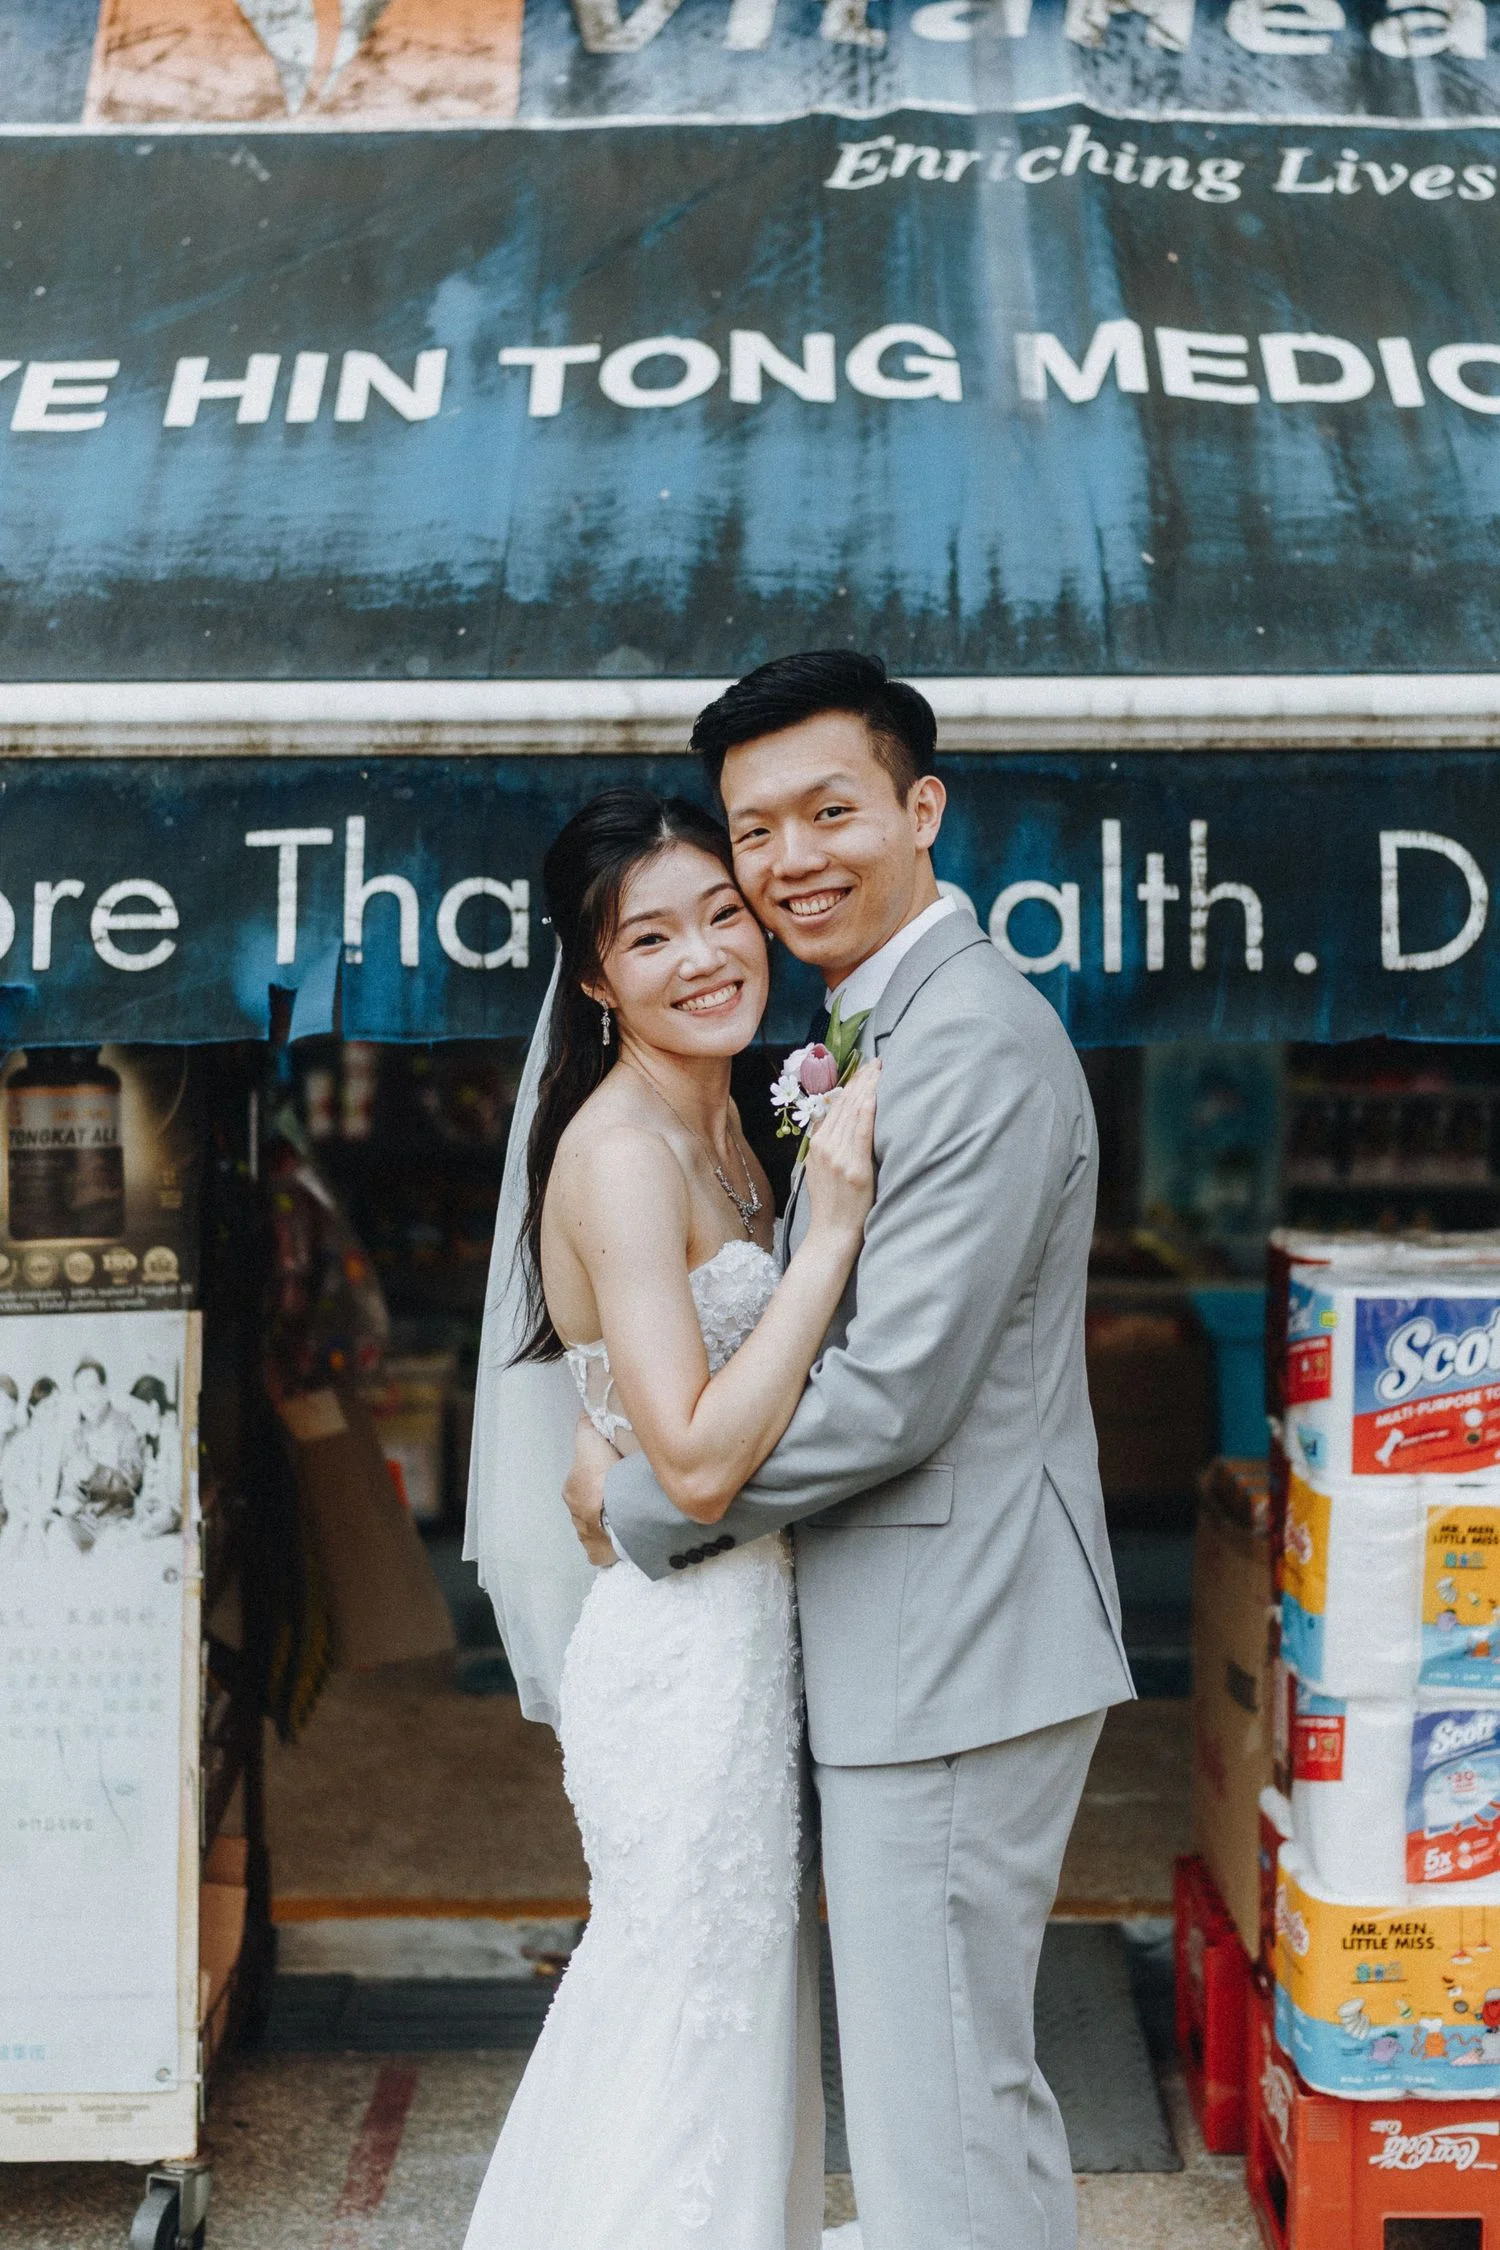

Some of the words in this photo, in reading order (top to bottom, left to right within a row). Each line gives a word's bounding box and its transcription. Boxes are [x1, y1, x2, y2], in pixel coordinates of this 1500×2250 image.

[823, 124, 1245, 203] Enriching
[1271, 147, 1497, 201] Lives
[163, 349, 447, 427] HIN
[499, 323, 962, 418] TONG
[0, 878, 179, 972] re
[935, 818, 1317, 975] alth.
[1379, 830, 1489, 971] D
[1428, 1712, 1496, 1757] Scott
[1343, 1937, 1388, 1950] LITTLE
[1395, 1937, 1435, 1949] MISS
